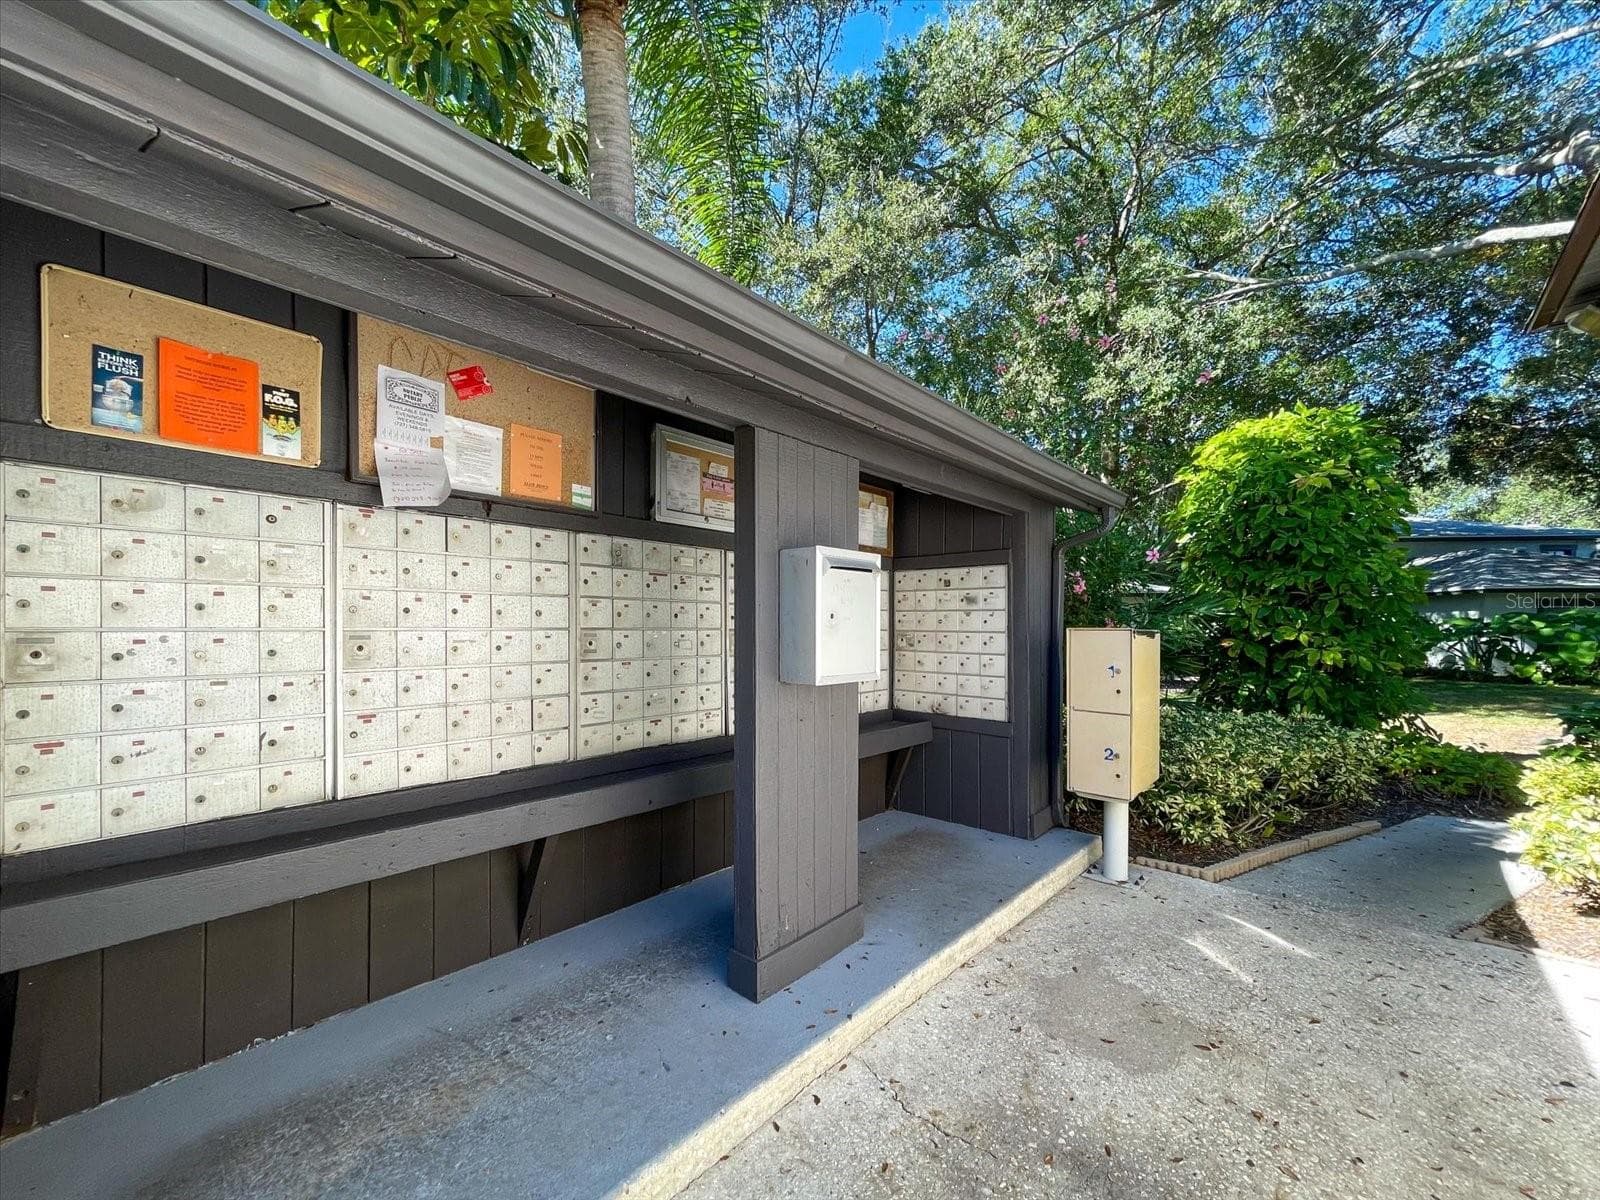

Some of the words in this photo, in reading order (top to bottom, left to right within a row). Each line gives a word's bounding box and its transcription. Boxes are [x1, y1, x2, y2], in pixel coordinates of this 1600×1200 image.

[98, 351, 138, 367] THINK
[97, 361, 139, 377] FLUSH
[1107, 665, 1115, 679] 1
[1104, 747, 1114, 761] 2
